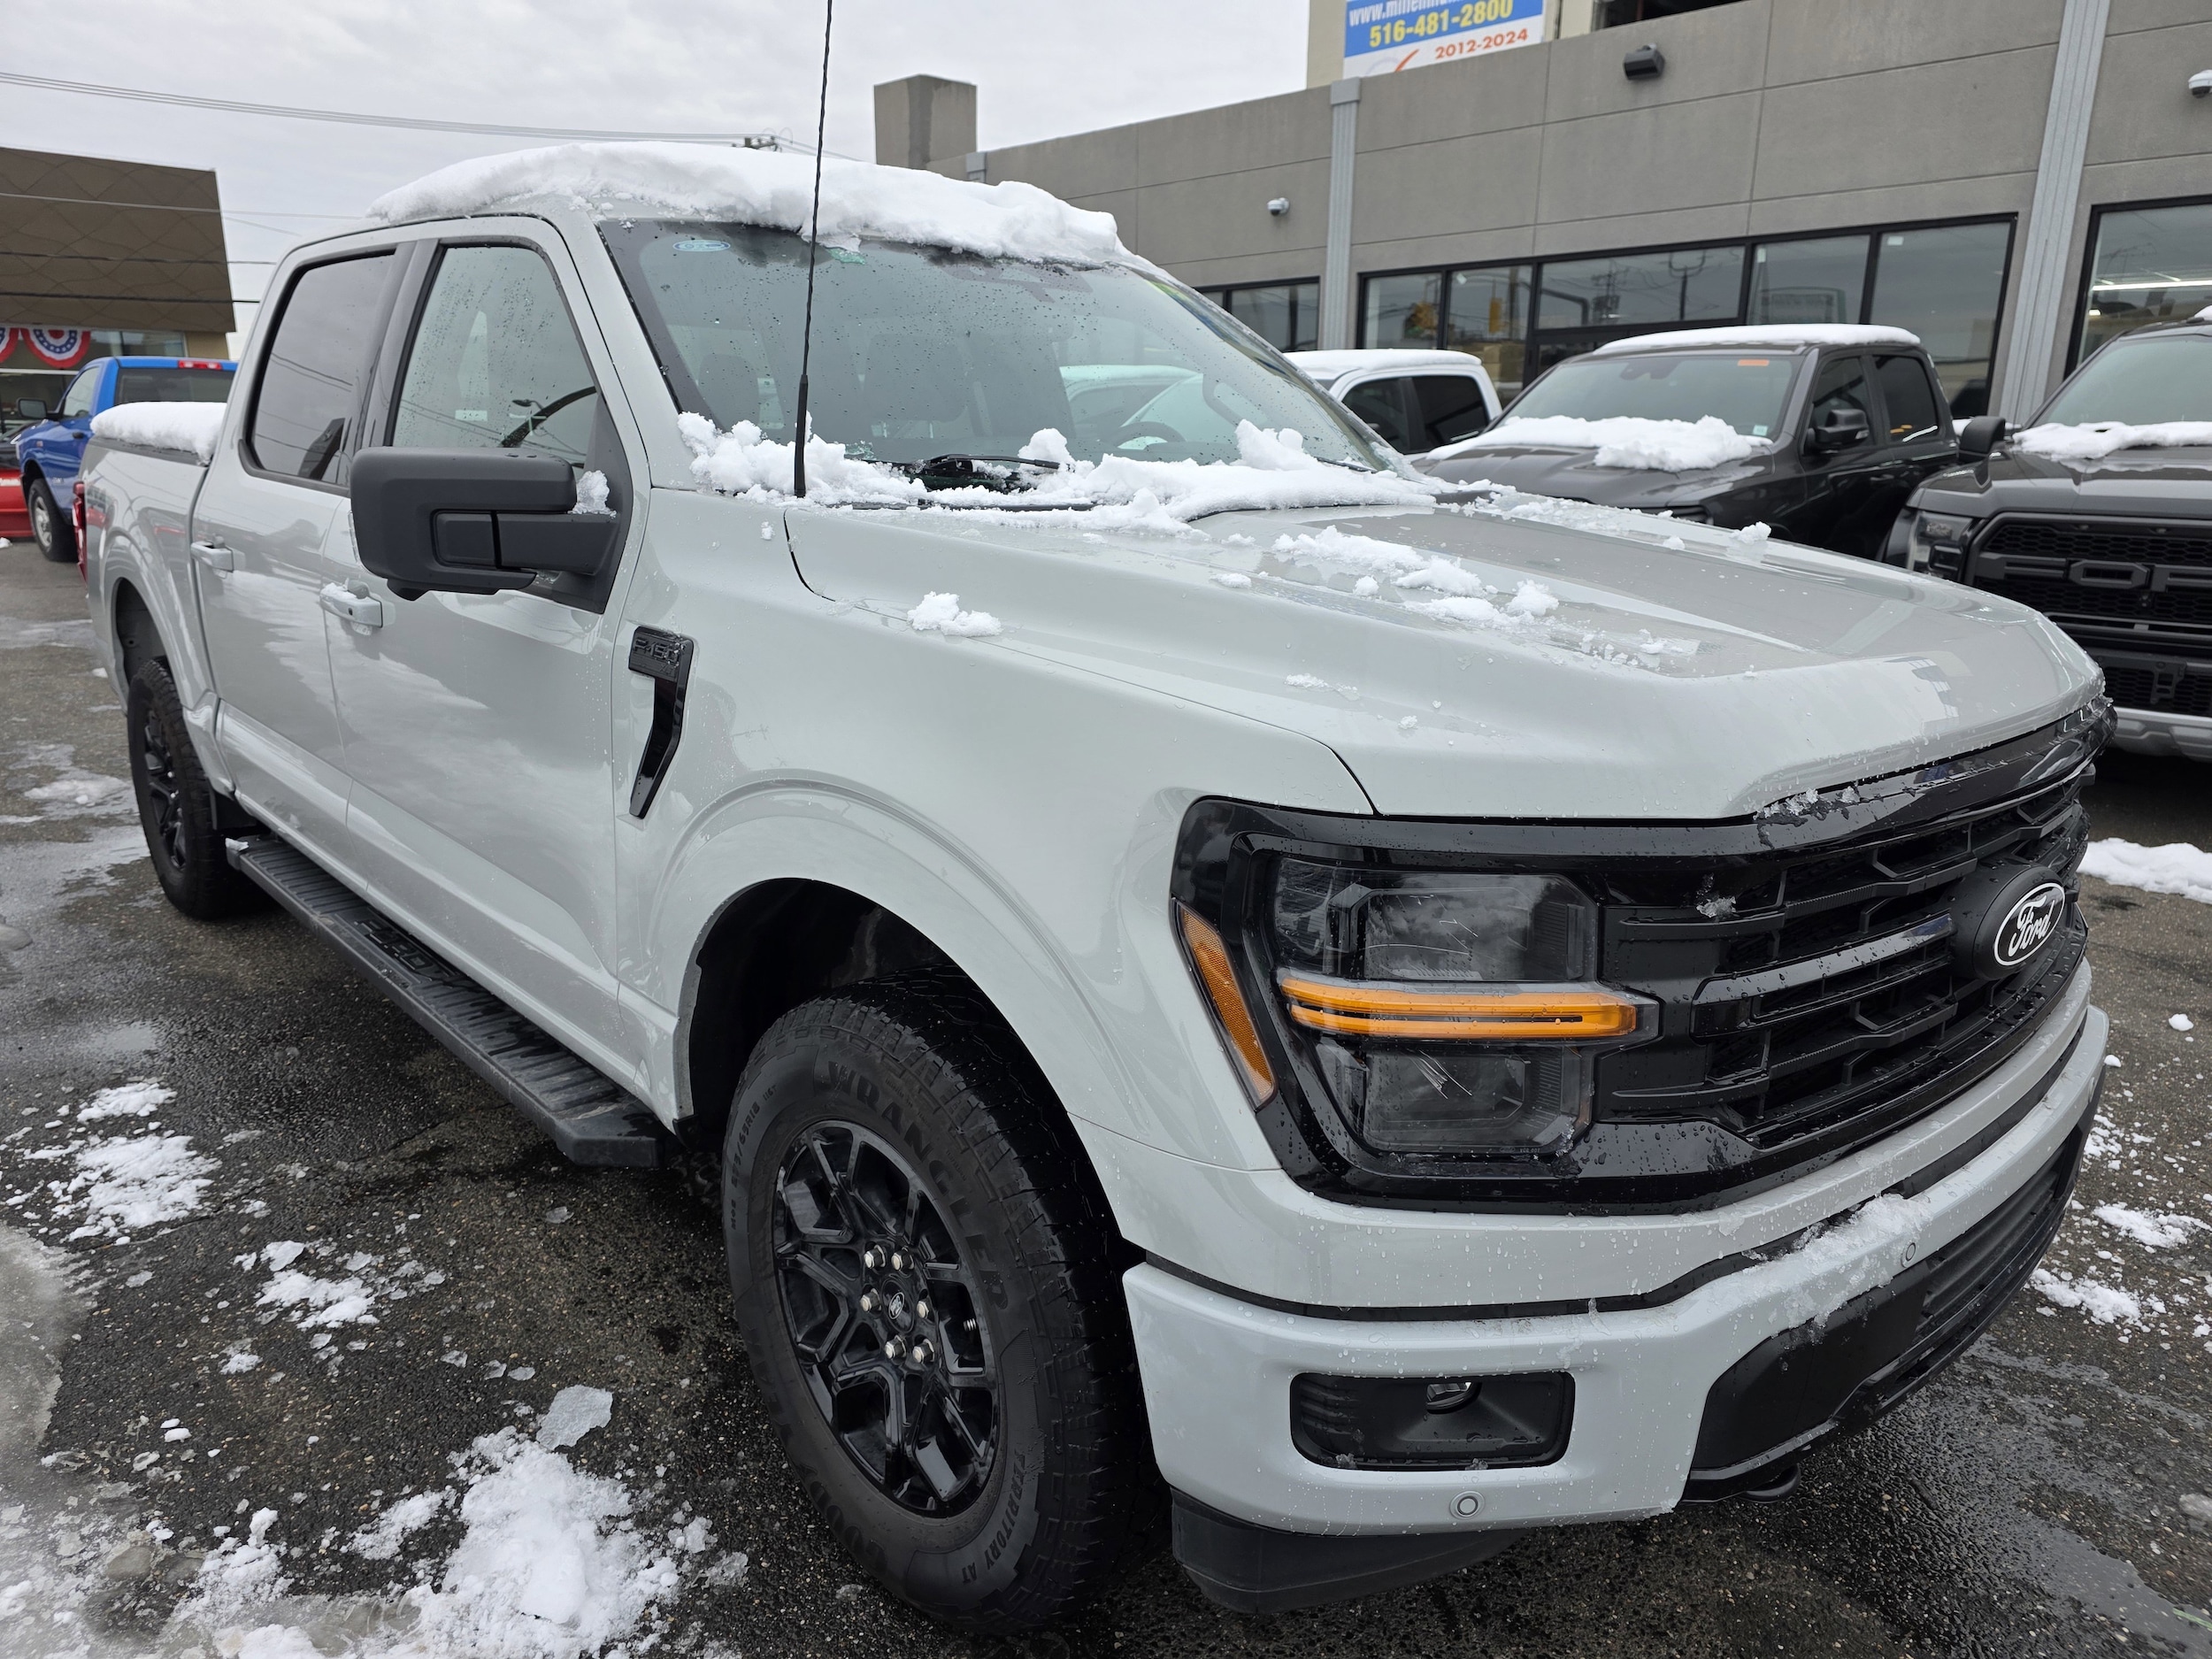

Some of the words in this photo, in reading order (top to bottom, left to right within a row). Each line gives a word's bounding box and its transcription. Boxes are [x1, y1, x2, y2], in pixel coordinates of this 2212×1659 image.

[1369, 0, 1513, 48] 516-481-2800
[1435, 28, 1529, 59] 2012-2024
[2008, 895, 2055, 956] Ford
[828, 1061, 1009, 1310] WRANGLER
[962, 1562, 978, 1584] AT
